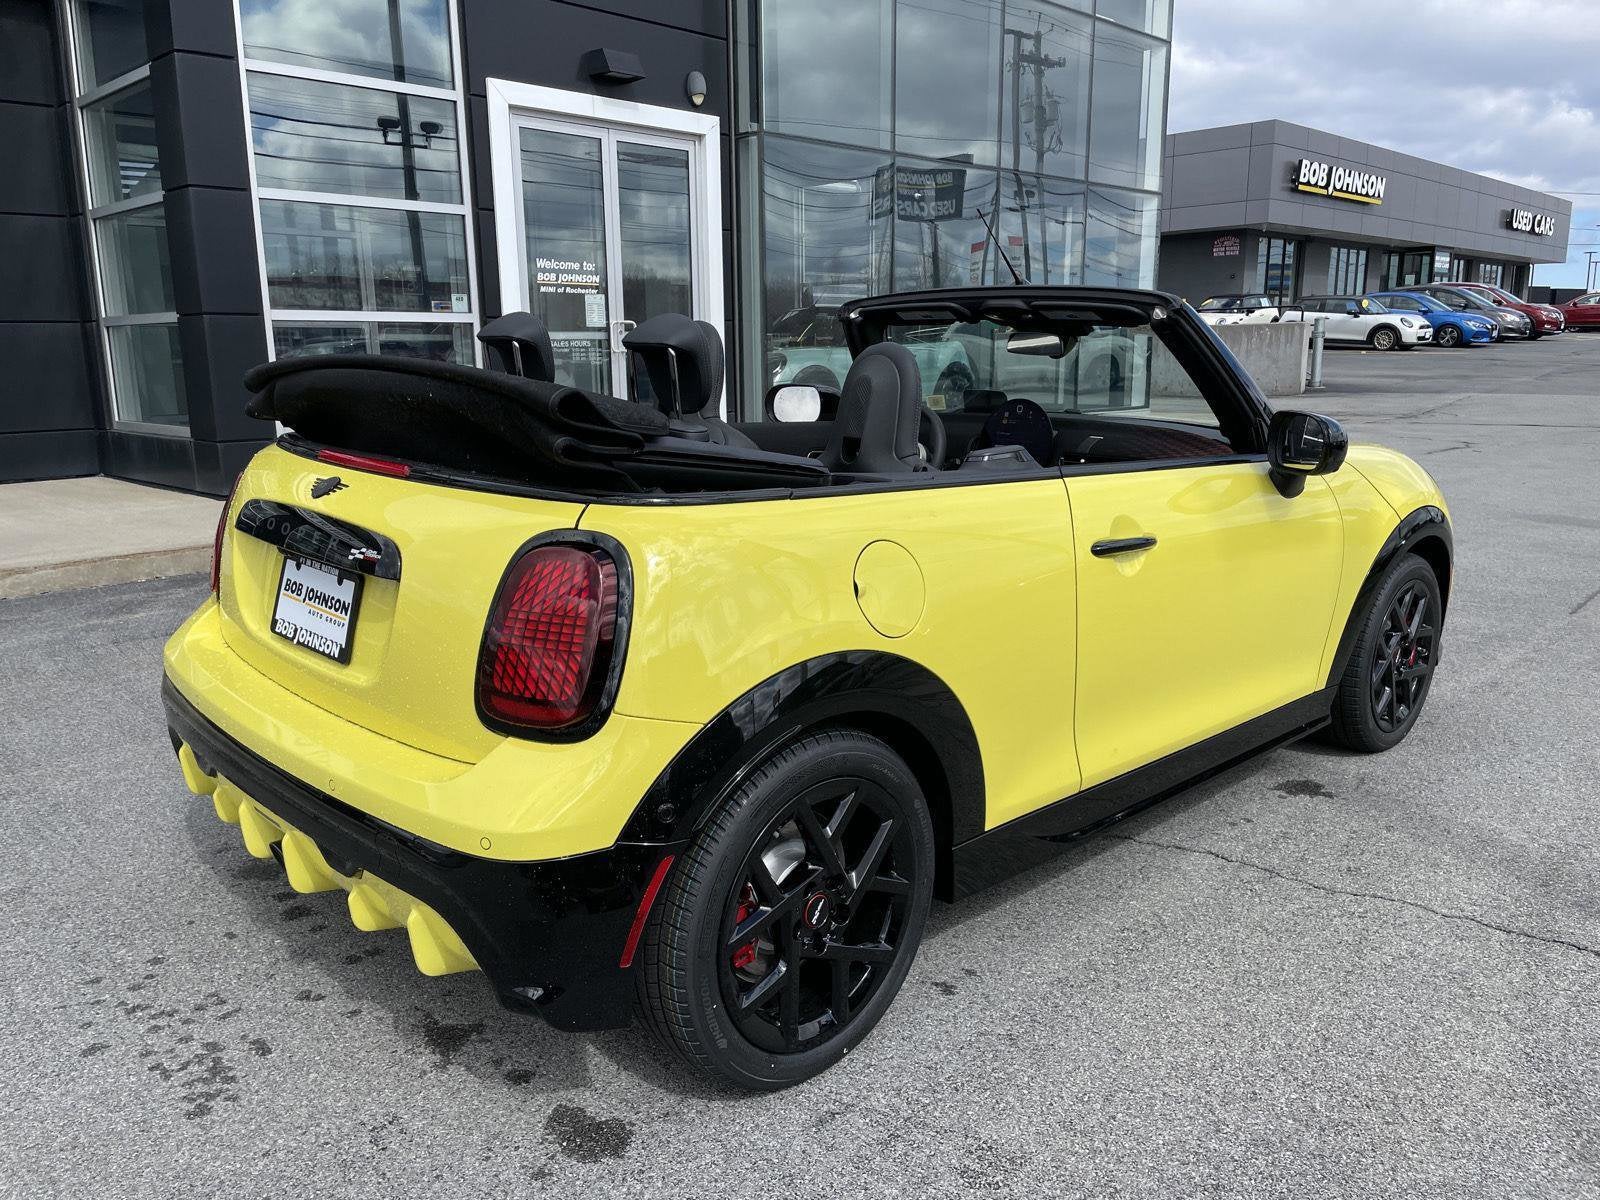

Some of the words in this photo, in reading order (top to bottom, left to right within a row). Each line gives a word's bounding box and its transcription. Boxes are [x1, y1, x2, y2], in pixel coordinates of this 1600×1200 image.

[1299, 158, 1328, 187] BOB
[1328, 165, 1387, 198] JOHNSON
[1512, 208, 1532, 232] USED
[1534, 213, 1555, 236] CARS
[536, 257, 580, 270] Welcome
[583, 260, 596, 271] to:
[537, 272, 556, 282] BOB
[558, 273, 600, 284] JOHNSON
[540, 285, 556, 293] MINI
[566, 287, 598, 295] Rochester
[312, 560, 321, 569] THE
[321, 563, 339, 576] NATION
[284, 578, 303, 596] BOB
[303, 586, 350, 616] JOHNSON
[308, 609, 323, 620] AUTO
[325, 615, 345, 628] GROUP
[275, 618, 295, 639] BOB
[294, 626, 340, 658] JOHNSON
